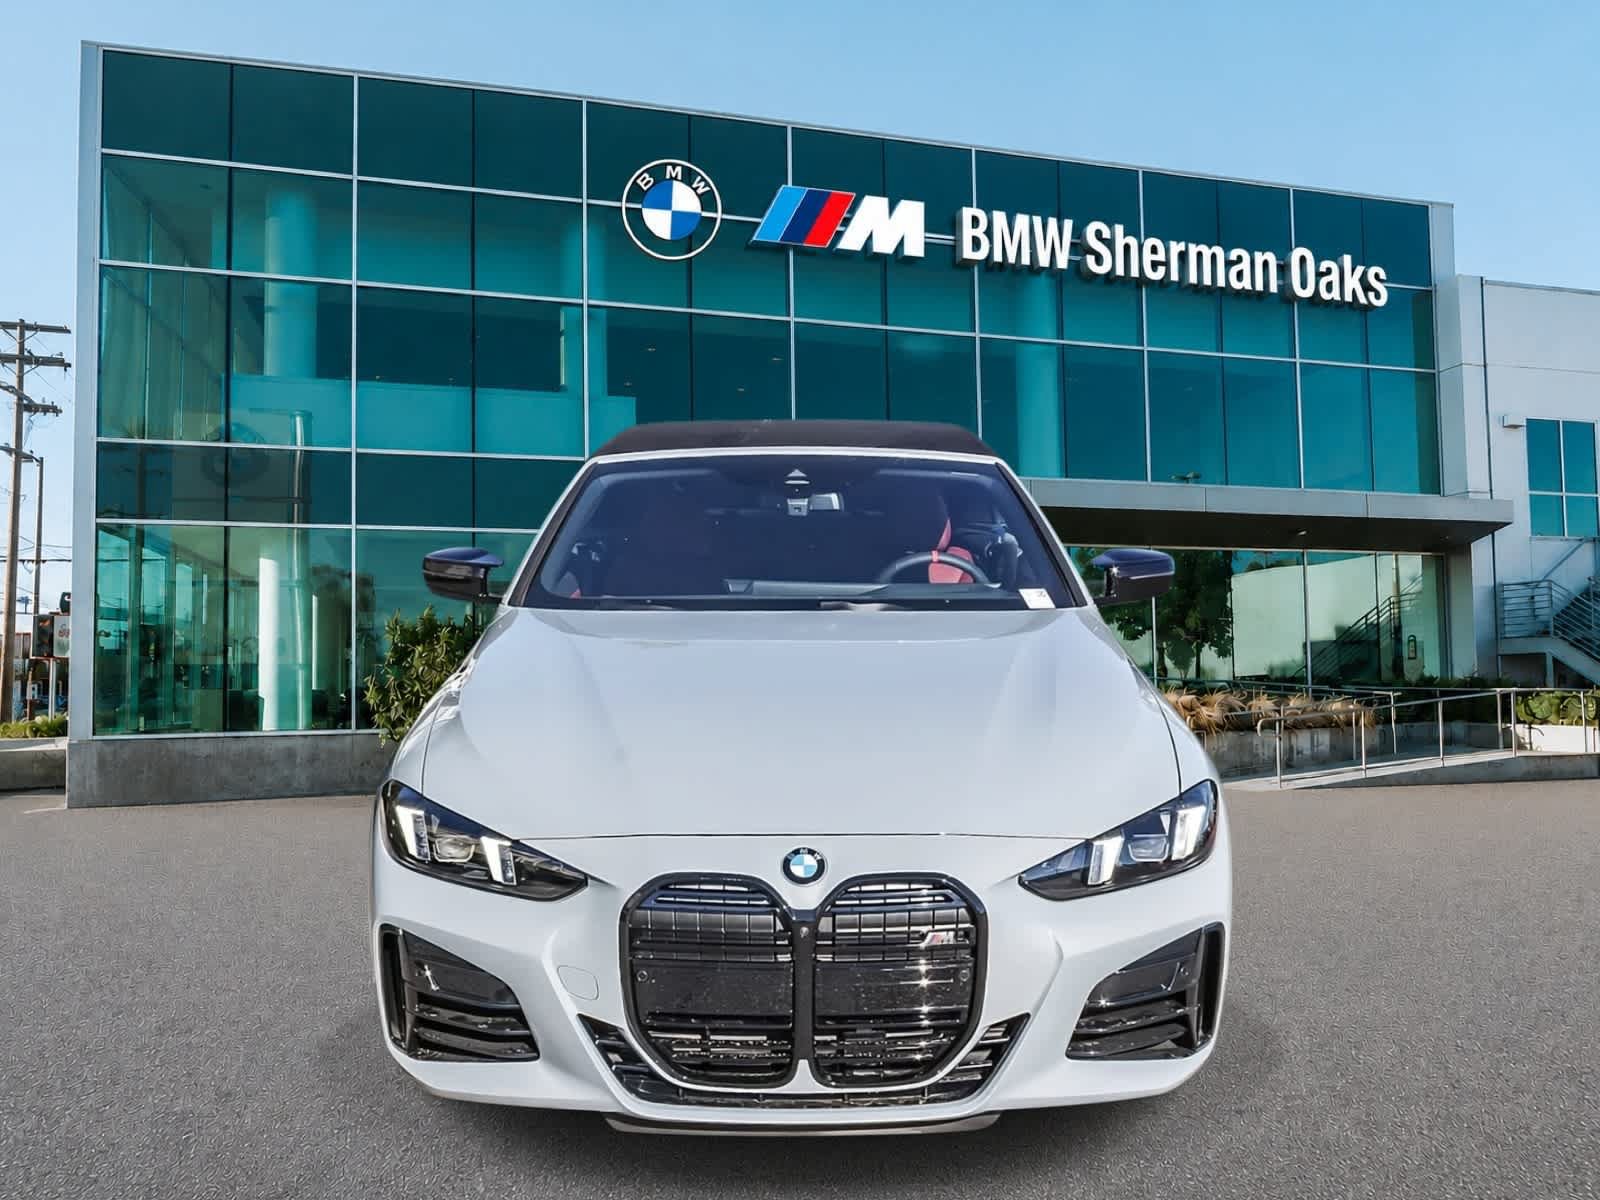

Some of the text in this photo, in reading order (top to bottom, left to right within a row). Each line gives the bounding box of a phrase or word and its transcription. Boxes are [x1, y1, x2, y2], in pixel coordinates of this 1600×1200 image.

[636, 164, 711, 195] BMW
[834, 194, 925, 258] M
[960, 206, 1388, 307] BMW Sherman Oaks
